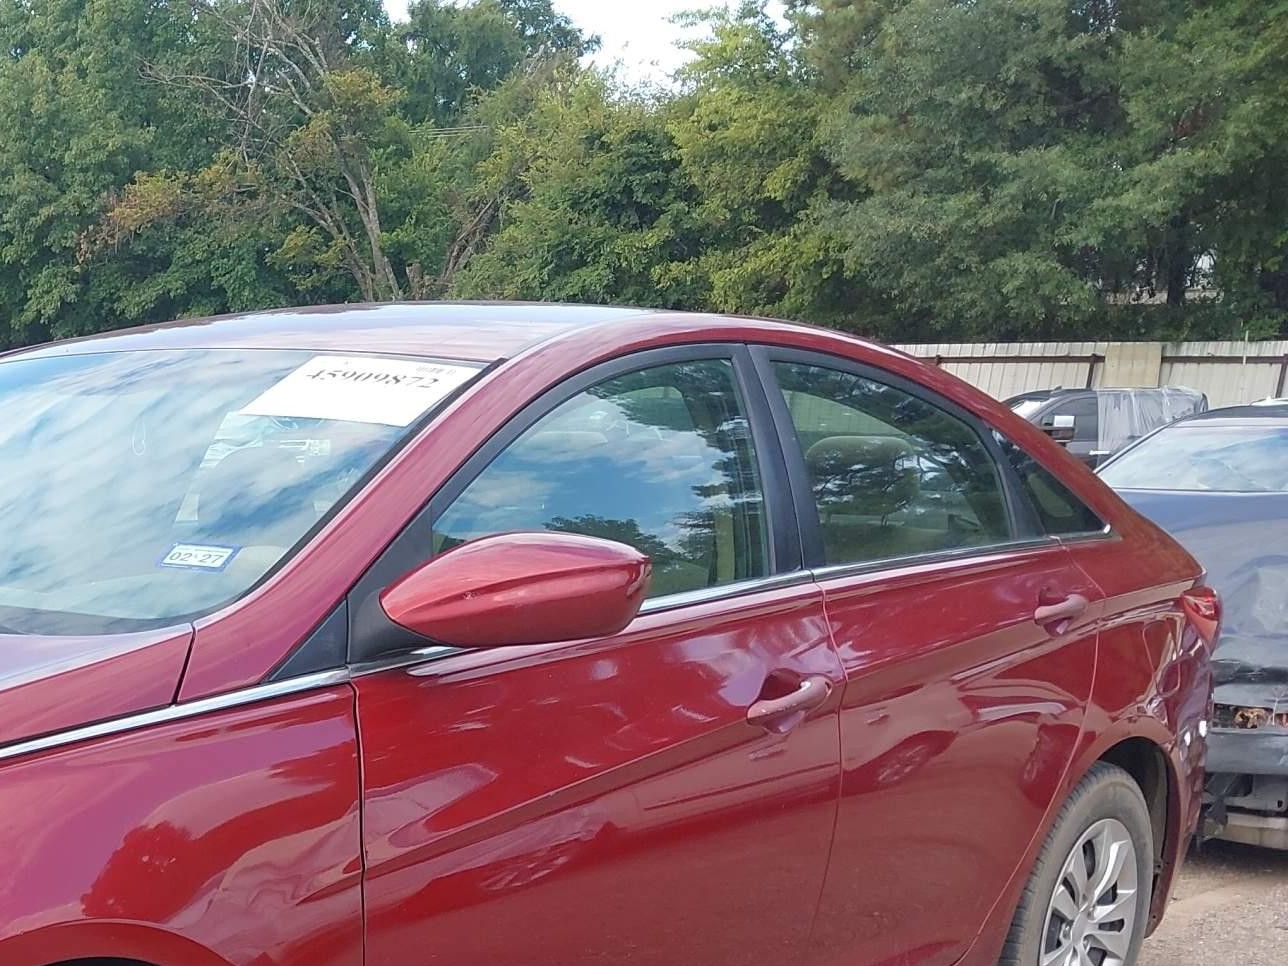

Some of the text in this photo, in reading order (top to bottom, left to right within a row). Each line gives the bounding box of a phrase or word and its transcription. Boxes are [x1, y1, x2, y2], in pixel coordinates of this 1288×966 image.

[306, 369, 440, 389] 45909872
[169, 551, 225, 564] 02 27
